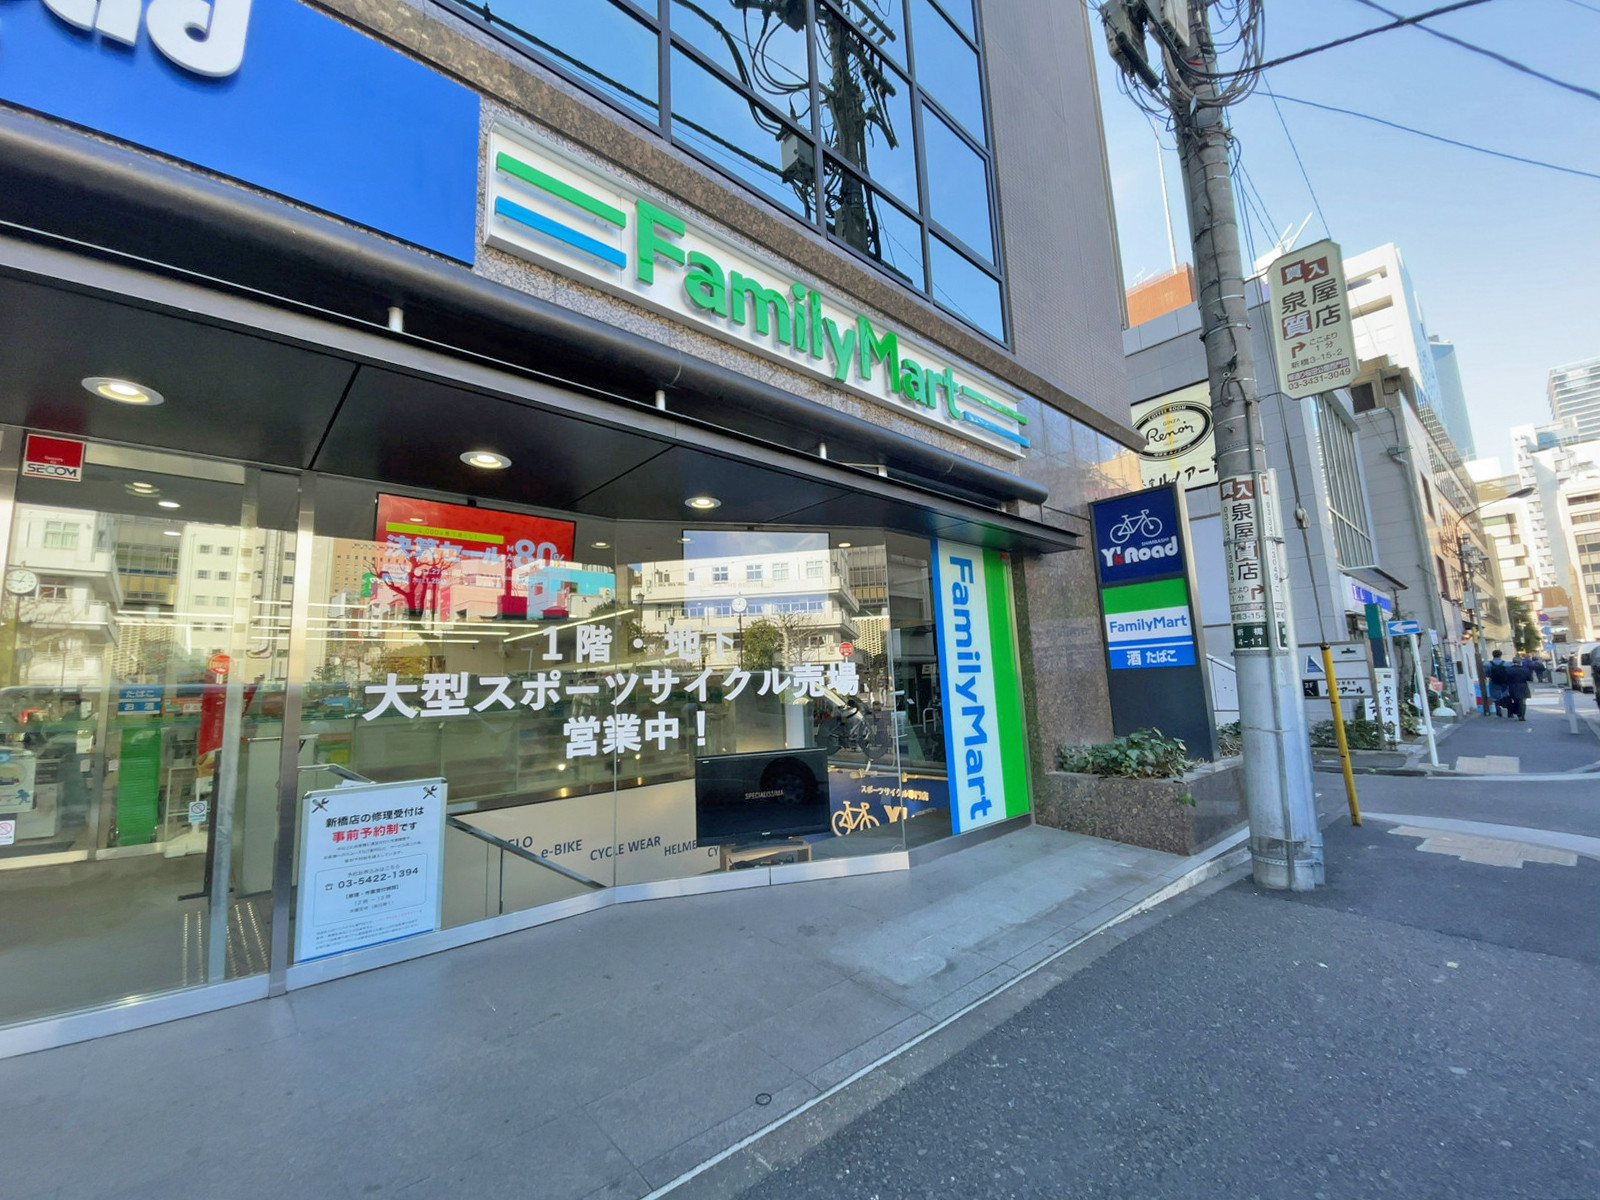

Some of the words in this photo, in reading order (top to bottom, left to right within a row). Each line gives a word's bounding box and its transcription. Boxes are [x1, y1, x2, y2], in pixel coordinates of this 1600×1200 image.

[634, 199, 961, 420] FamilyMart
[1287, 367, 1351, 391] 03-3431-3049
[27, 463, 78, 478] SECOM
[1124, 536, 1179, 564] Road
[1109, 614, 1188, 633] FamilyMart
[1238, 637, 1262, 645] 4-11
[1126, 650, 1142, 666] 酒
[1146, 649, 1178, 664] たばこ
[362, 662, 859, 721] 大型スポーツサイクル売場
[949, 556, 992, 820] FamilyMart
[325, 806, 425, 829] 新橋店の修理受付は
[332, 821, 418, 844] 事前予約制です
[541, 838, 584, 858] e-BIKE
[589, 834, 625, 861] CYCLE
[627, 835, 662, 854] WEAR
[337, 867, 419, 889] 03-5422-1394
